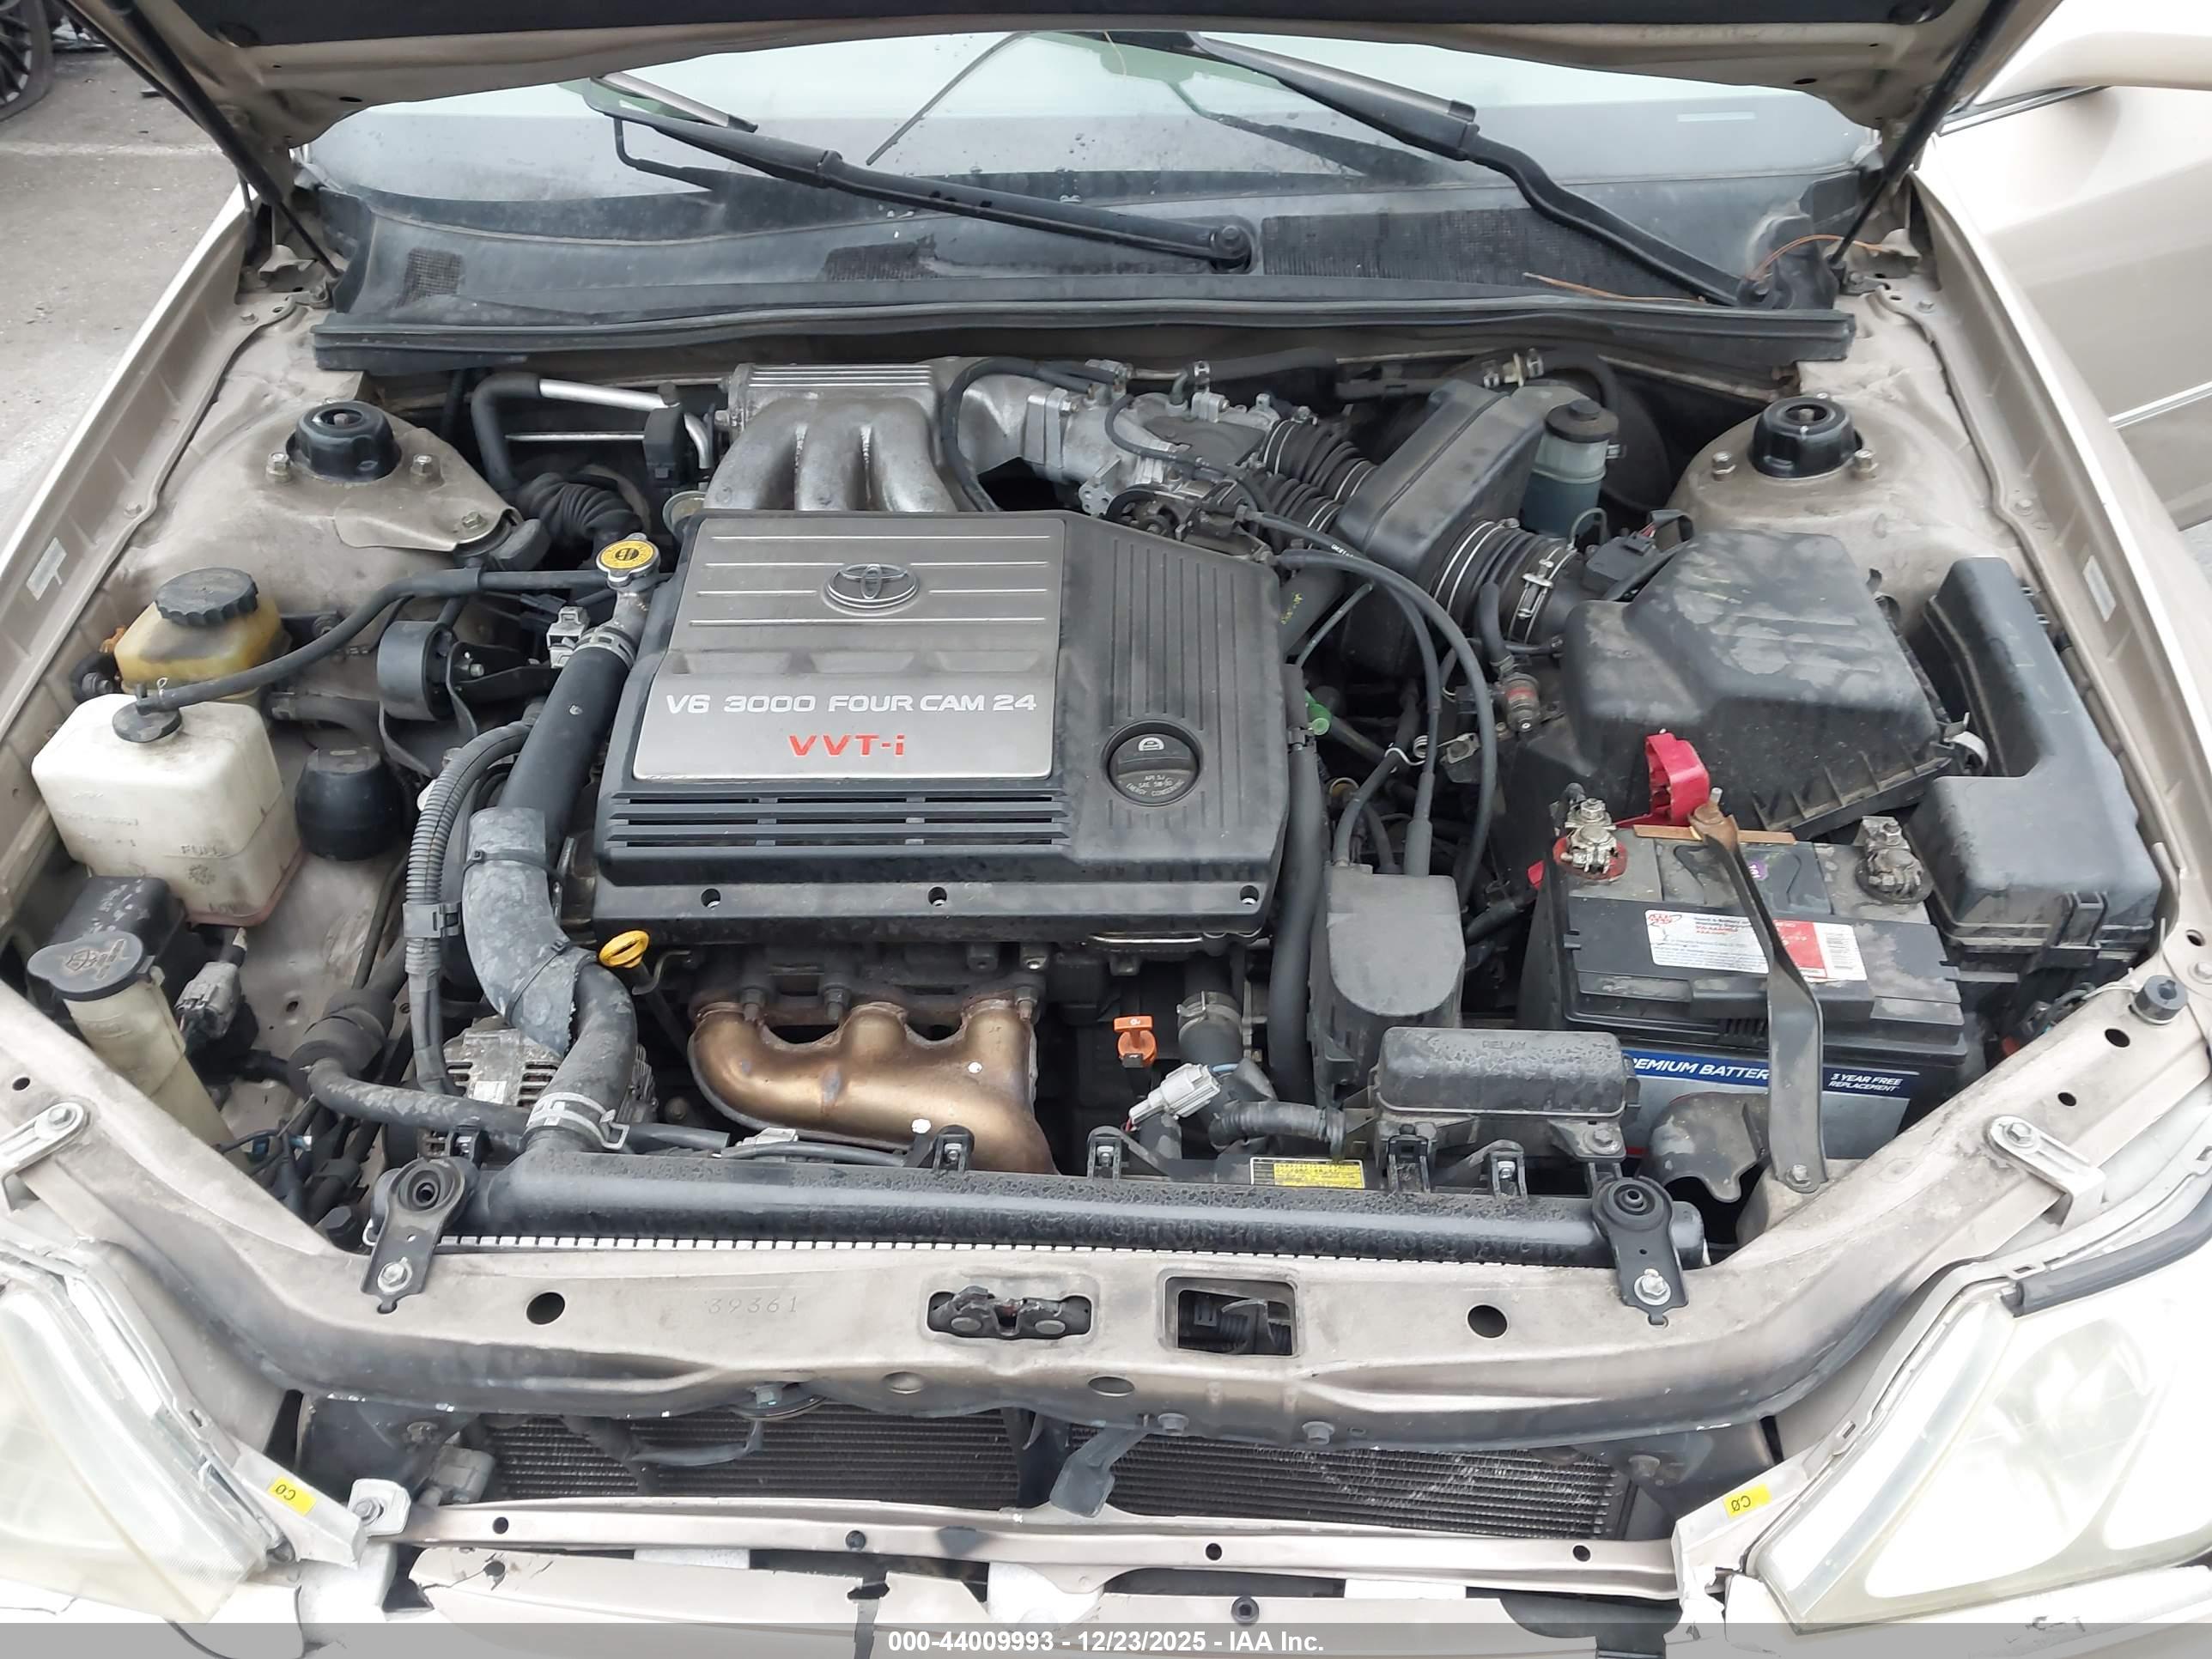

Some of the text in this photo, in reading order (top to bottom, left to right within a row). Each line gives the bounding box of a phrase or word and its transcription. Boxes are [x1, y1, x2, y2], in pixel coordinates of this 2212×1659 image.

[666, 693, 1037, 714] V6 3000 FOUR CAM 24
[788, 734, 906, 757] VVT-i
[1699, 1063, 1770, 1080] BATTER
[1841, 1074, 1872, 1083] YEAR
[1871, 1077, 1904, 1085] FREE
[1828, 1081, 1897, 1091] REPLACEMENT
